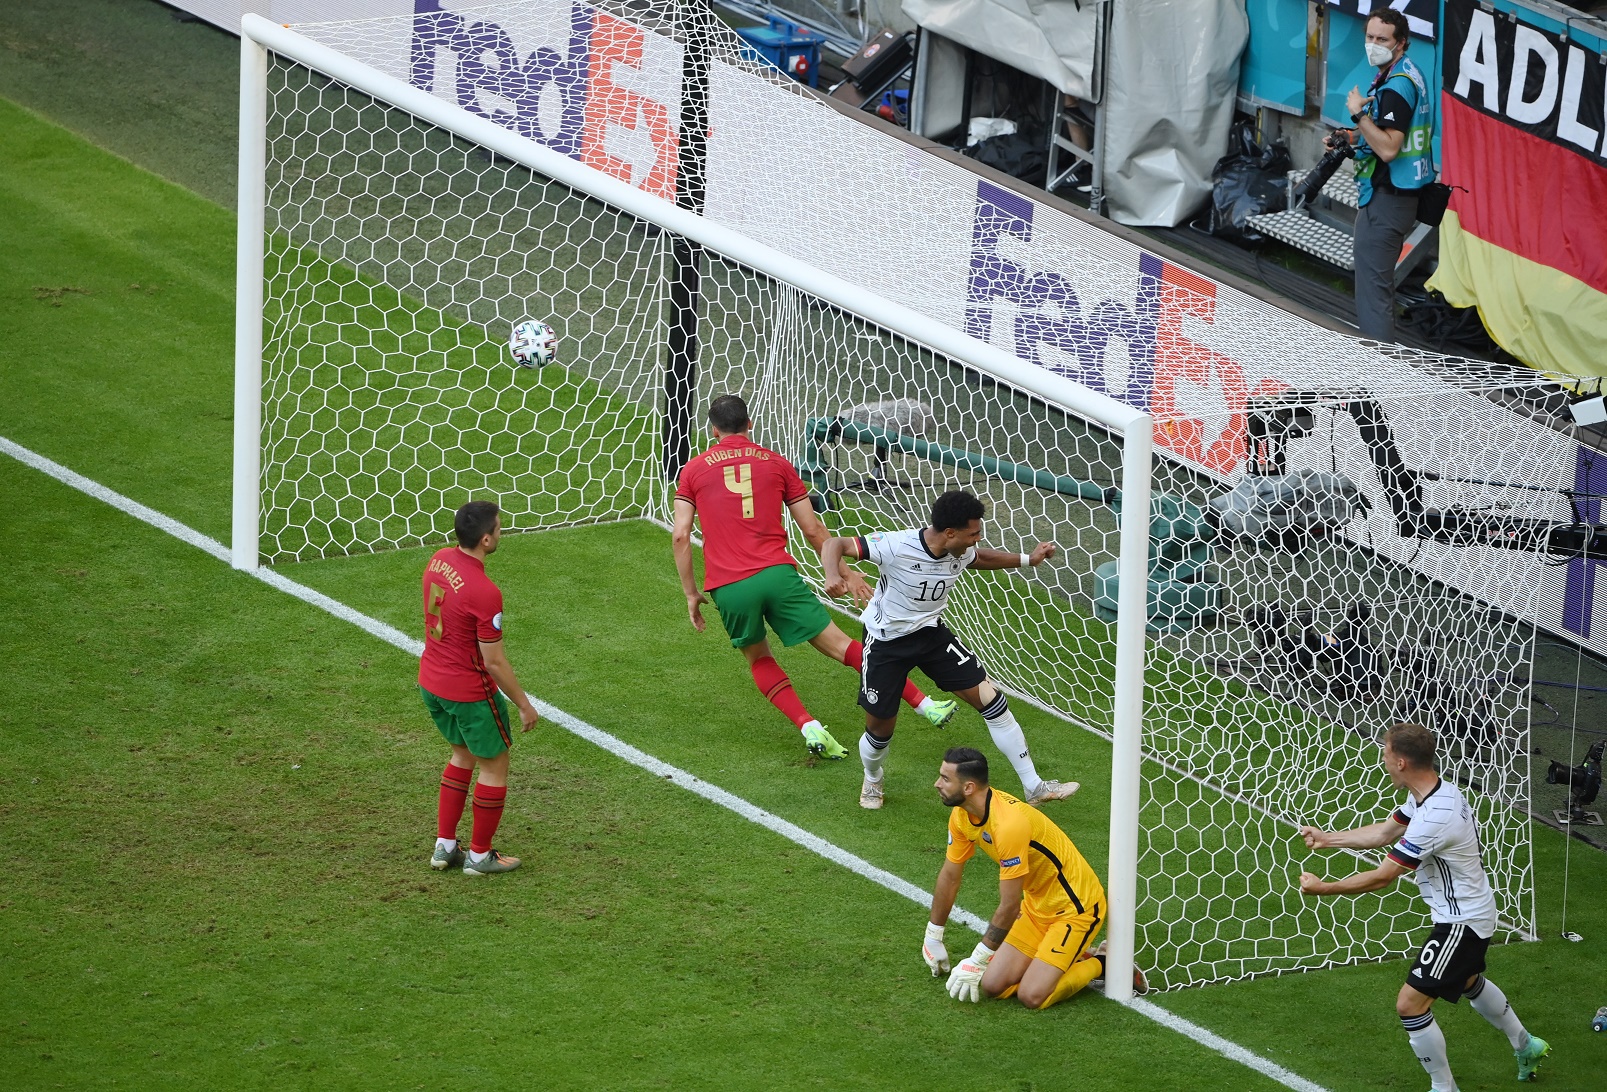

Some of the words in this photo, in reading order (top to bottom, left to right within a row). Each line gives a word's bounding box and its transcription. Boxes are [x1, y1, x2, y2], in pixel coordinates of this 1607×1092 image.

[1454, 9, 1607, 158] ADL
[723, 463, 754, 518] 4
[429, 559, 465, 593] RAPHAEL
[914, 580, 945, 601] 10
[428, 582, 446, 640] 5
[1061, 923, 1072, 947] 1
[1420, 940, 1440, 965] 6
